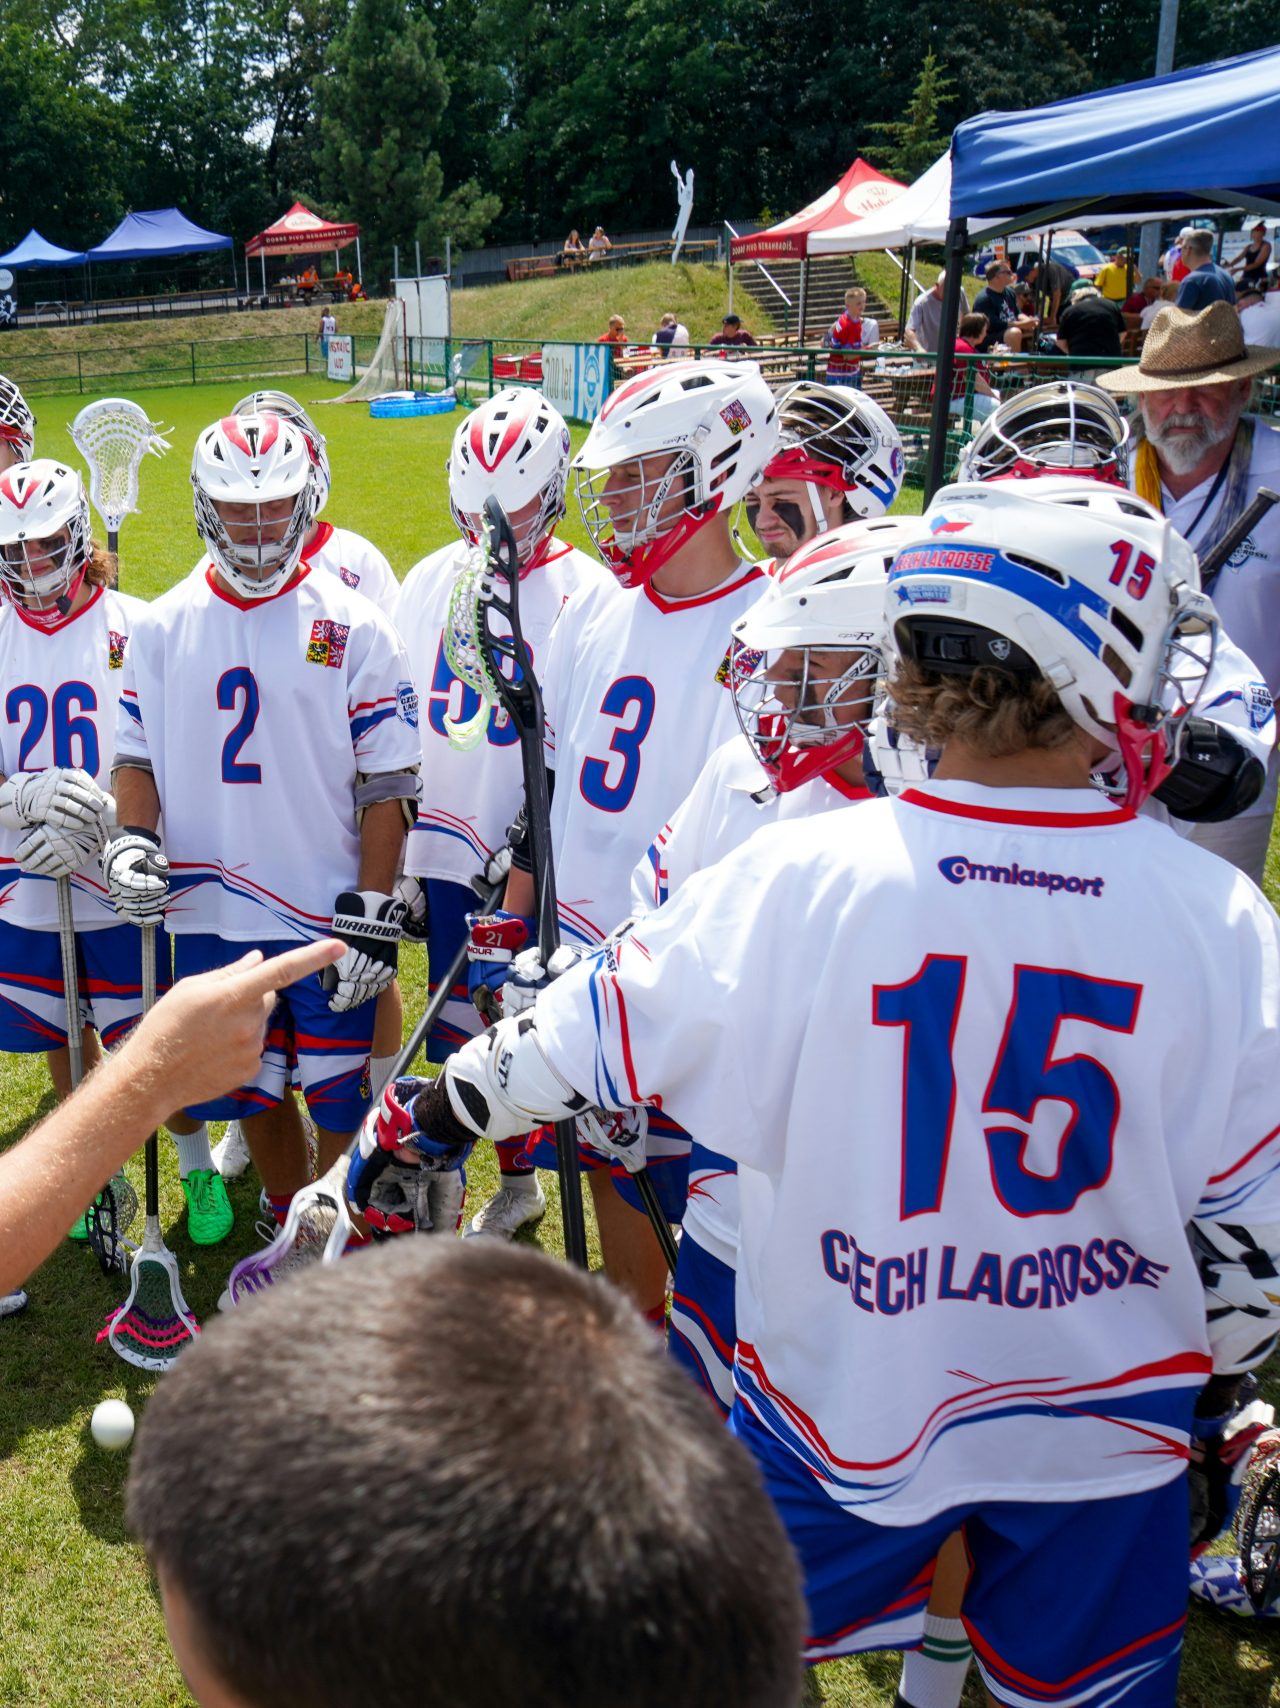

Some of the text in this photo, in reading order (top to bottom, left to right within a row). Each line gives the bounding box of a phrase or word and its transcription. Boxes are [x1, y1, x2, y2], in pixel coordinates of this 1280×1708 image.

[745, 243, 757, 253] PIVO
[921, 550, 996, 573] LACROSSE
[1108, 538, 1157, 601] 15
[5, 680, 100, 781] 26
[216, 666, 262, 784] 2
[580, 675, 656, 813] 3
[334, 918, 401, 938] WARRIOR
[485, 930, 503, 947] 21
[872, 953, 1144, 1222] 15
[820, 1228, 1170, 1316] CECH LACROSSE
